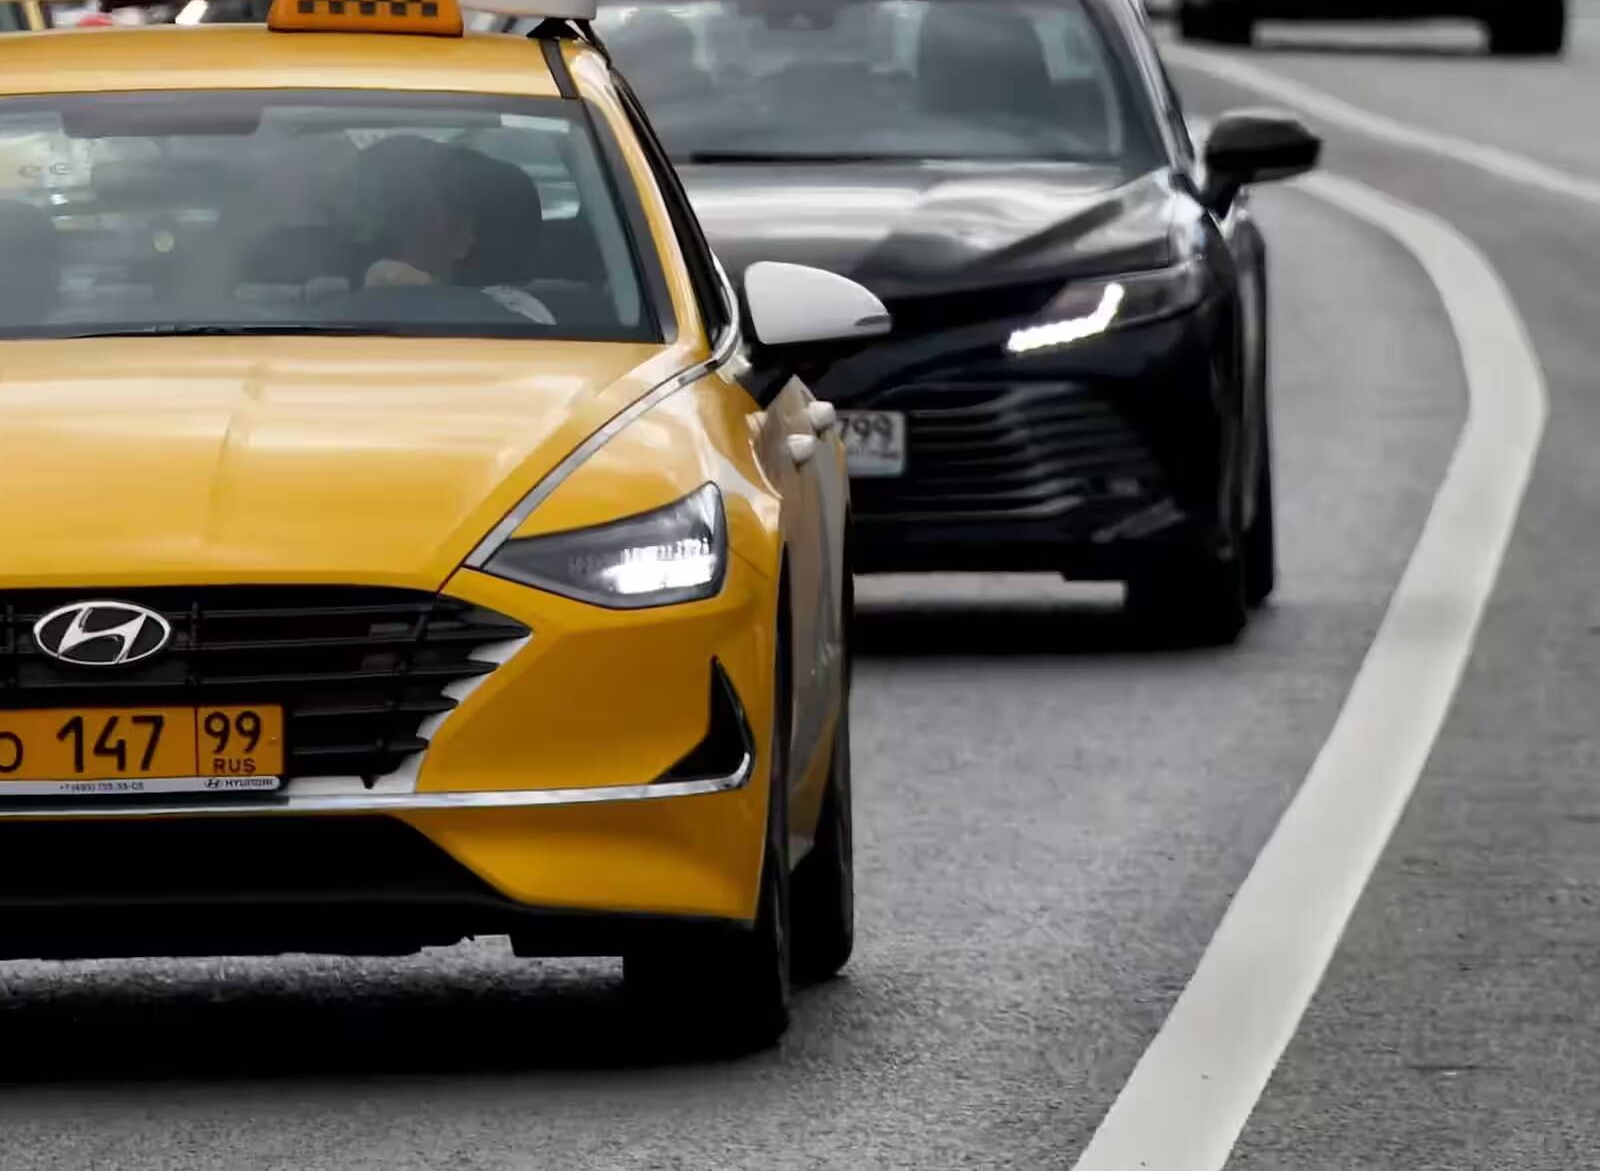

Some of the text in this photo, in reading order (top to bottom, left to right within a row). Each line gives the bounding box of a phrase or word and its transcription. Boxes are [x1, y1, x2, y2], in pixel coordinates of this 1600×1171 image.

[56, 715, 165, 772] 147
[203, 710, 262, 755] 99
[213, 757, 257, 773] RUS
